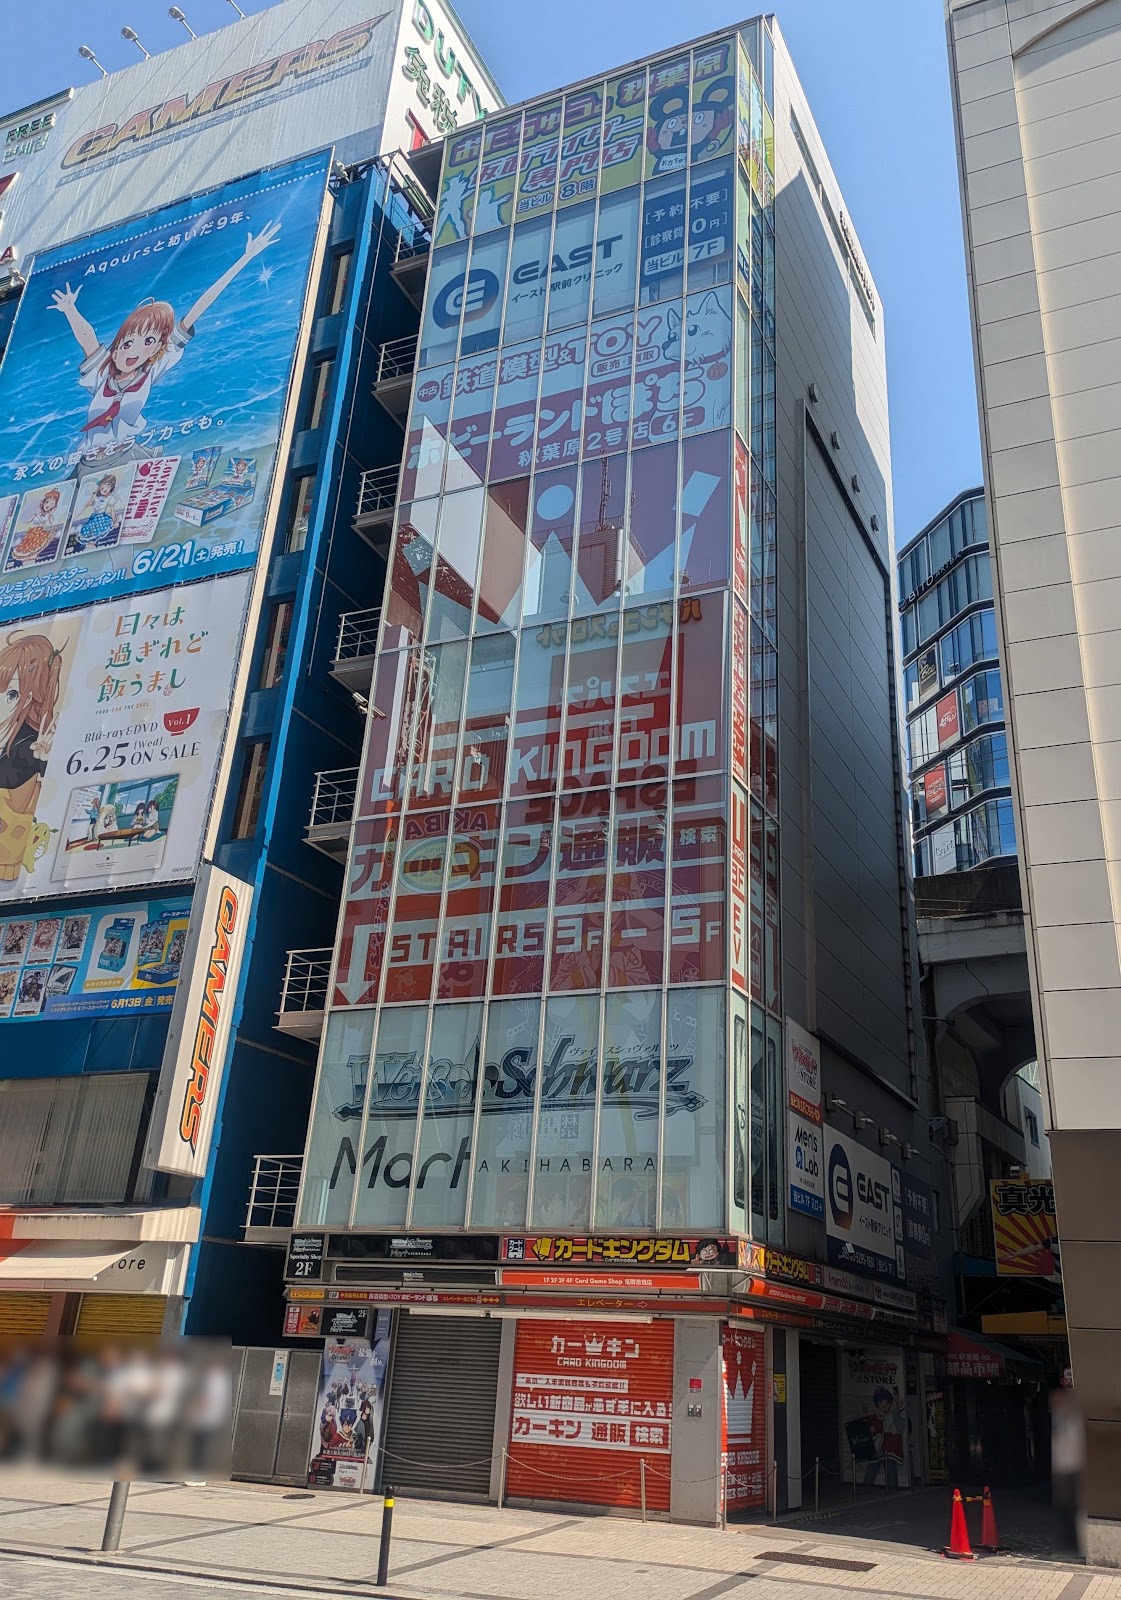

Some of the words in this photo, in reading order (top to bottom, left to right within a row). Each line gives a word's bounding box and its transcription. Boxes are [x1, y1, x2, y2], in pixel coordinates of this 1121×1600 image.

[61, 10, 392, 169] GAMERS
[622, 57, 723, 101] 秋葉原
[5, 112, 56, 143] FREE
[468, 117, 645, 189] 仮面ライダー
[513, 235, 622, 285] EAST
[660, 410, 695, 430] 6F
[518, 421, 650, 468] 秋葉原2号店
[133, 541, 193, 575] 6/21
[196, 550, 207, 562] 土
[210, 540, 244, 559] 発売!
[115, 606, 186, 638] 日々は
[105, 631, 209, 670] 過ぎれど
[97, 668, 187, 704] 飯うまし
[85, 721, 159, 744] Blu-ray&DVD
[168, 713, 192, 727] Vol.1
[65, 741, 130, 777] 6.25
[130, 749, 155, 766] ON
[159, 741, 202, 762] SALE
[391, 920, 546, 964] STAIRS
[111, 997, 141, 1009] 6月13日
[179, 884, 239, 1158] GAMERS
[795, 1124, 818, 1153] Men's
[477, 1157, 656, 1174] AKIHABARA
[803, 1149, 819, 1178] Lab
[857, 1171, 891, 1215] EAST
[311, 1253, 323, 1261] Shop
[555, 1237, 691, 1262] カードキングダム
[294, 1261, 314, 1277] 2F
[575, 1277, 589, 1285] Card
[608, 1278, 623, 1288] Shop
[358, 1309, 369, 1318] 2F
[576, 1298, 634, 1309] エレベーター
[551, 1334, 640, 1359] カーキン
[557, 1356, 582, 1367] CARD
[585, 1357, 628, 1370] KINGDOM
[863, 1373, 897, 1387] STORE
[514, 1416, 582, 1439] カーキン
[592, 1421, 627, 1444] 通販
[635, 1425, 664, 1446] 検索
